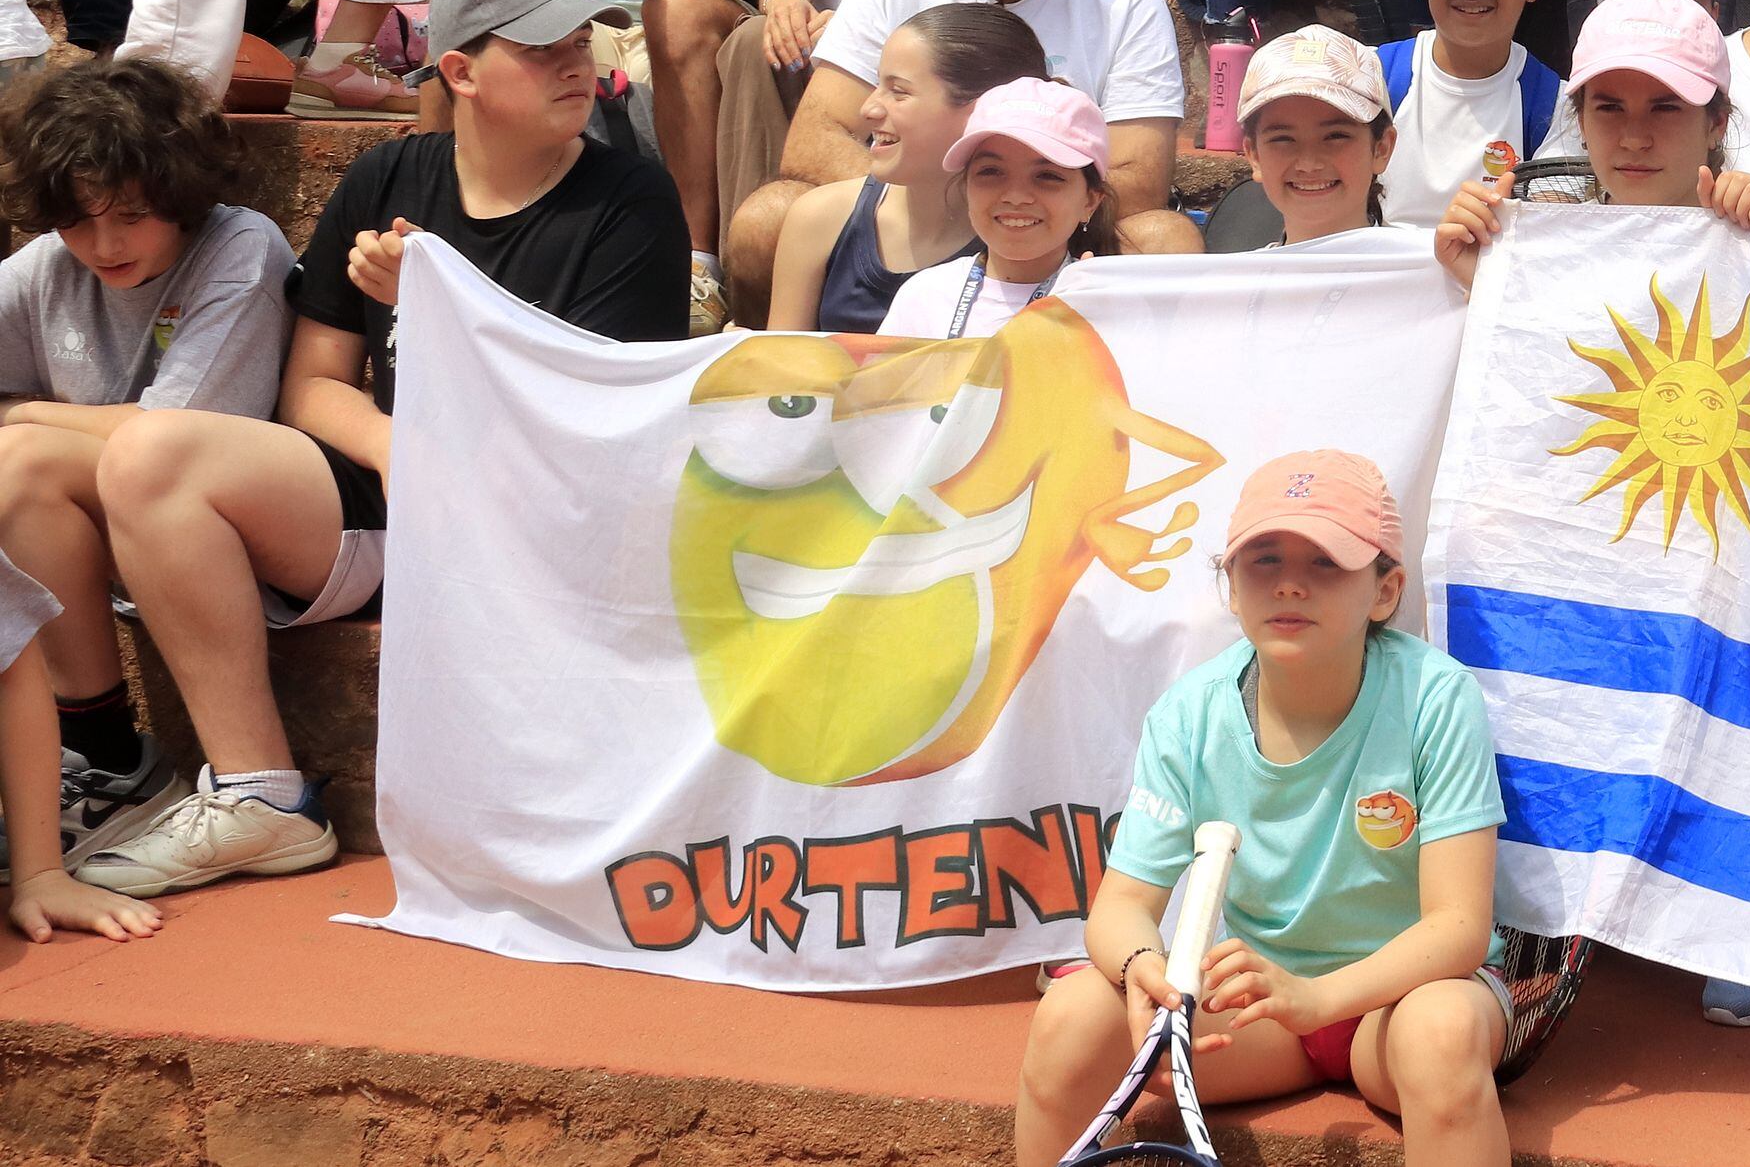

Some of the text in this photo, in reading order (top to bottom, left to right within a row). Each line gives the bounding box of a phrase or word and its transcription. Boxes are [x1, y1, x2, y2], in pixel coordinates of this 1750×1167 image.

[1214, 61, 1228, 109] Sport
[949, 279, 979, 336] ARGENTINA
[1285, 473, 1314, 498] Z
[603, 803, 1121, 954] DURTENI
